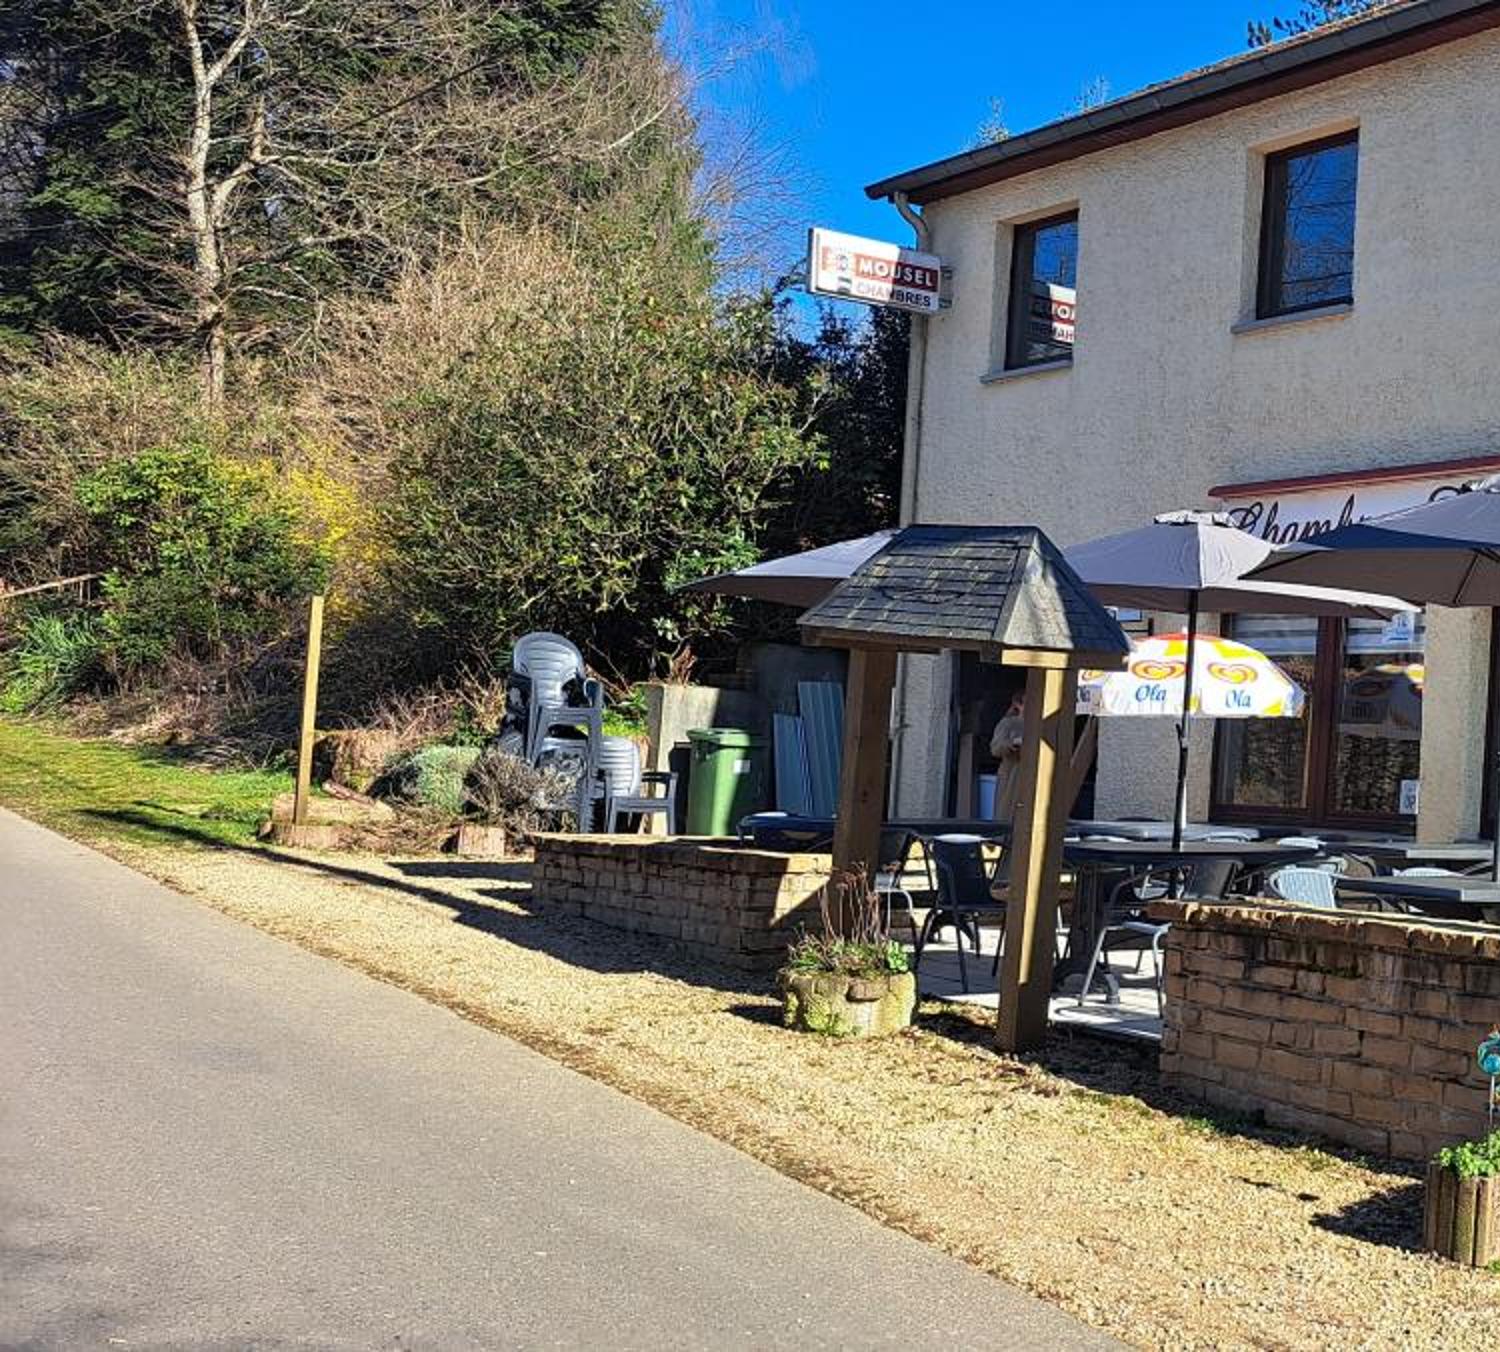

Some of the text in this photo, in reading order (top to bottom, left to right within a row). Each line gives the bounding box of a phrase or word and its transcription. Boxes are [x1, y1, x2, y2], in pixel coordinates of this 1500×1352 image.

[860, 257, 934, 287] MOUSEL
[856, 282, 932, 307] CHAMBRES
[1134, 684, 1167, 702] Ola
[1225, 689, 1252, 708] Ola
